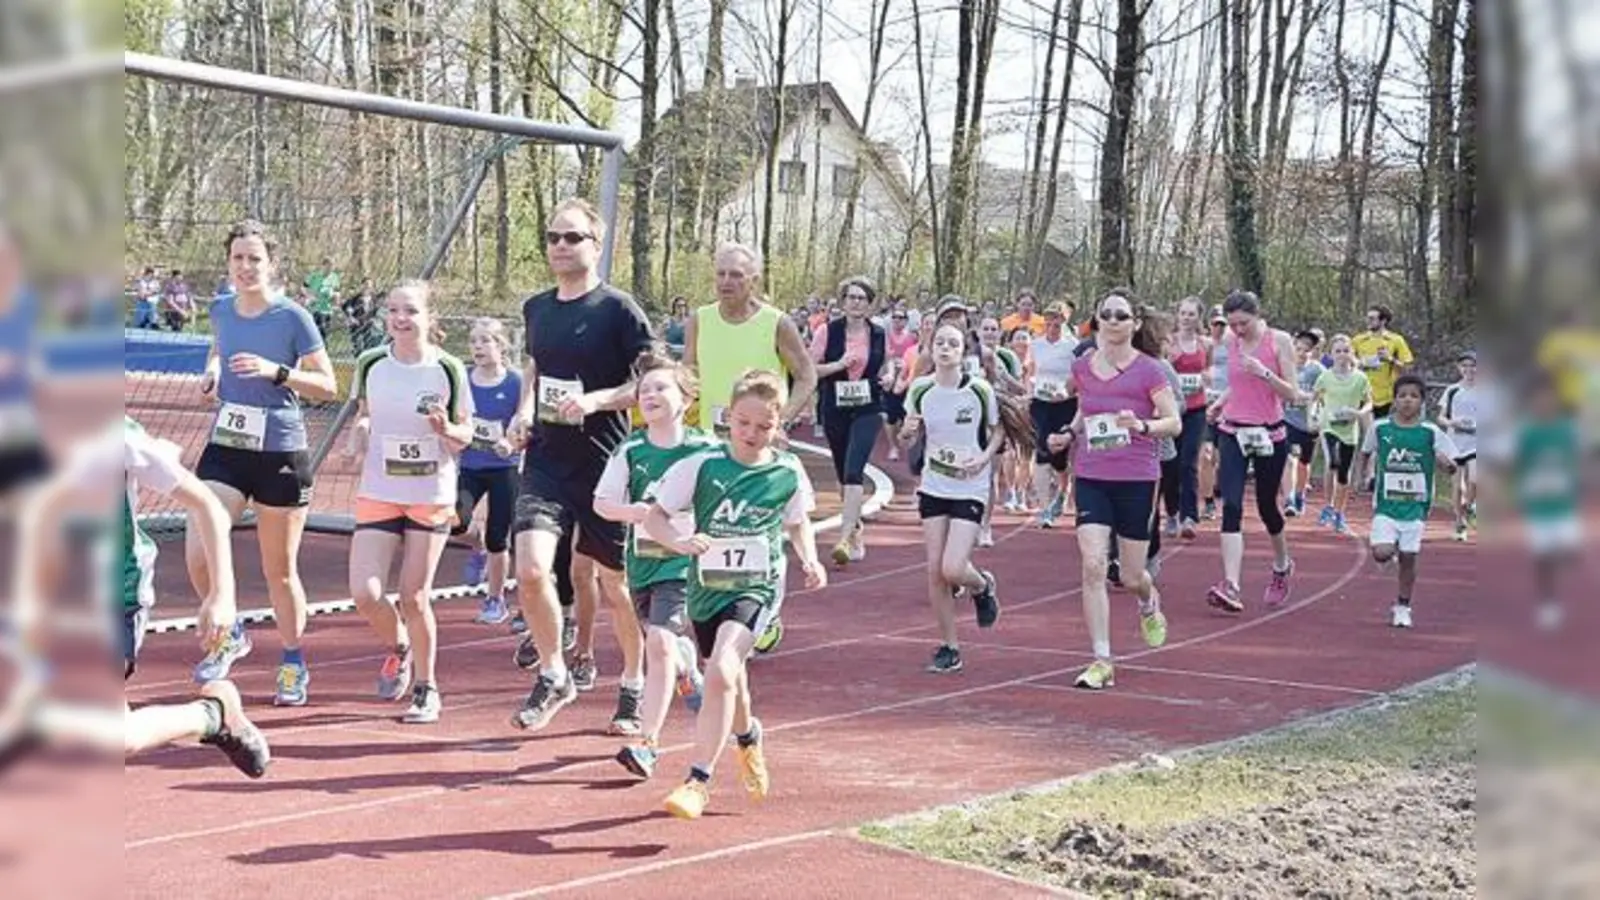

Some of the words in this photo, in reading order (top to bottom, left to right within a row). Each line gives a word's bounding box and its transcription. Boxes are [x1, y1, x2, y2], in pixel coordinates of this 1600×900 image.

[228, 411, 246, 430] 78
[1099, 422, 1108, 435] 9
[399, 443, 421, 459] 55
[722, 549, 747, 568] 17
